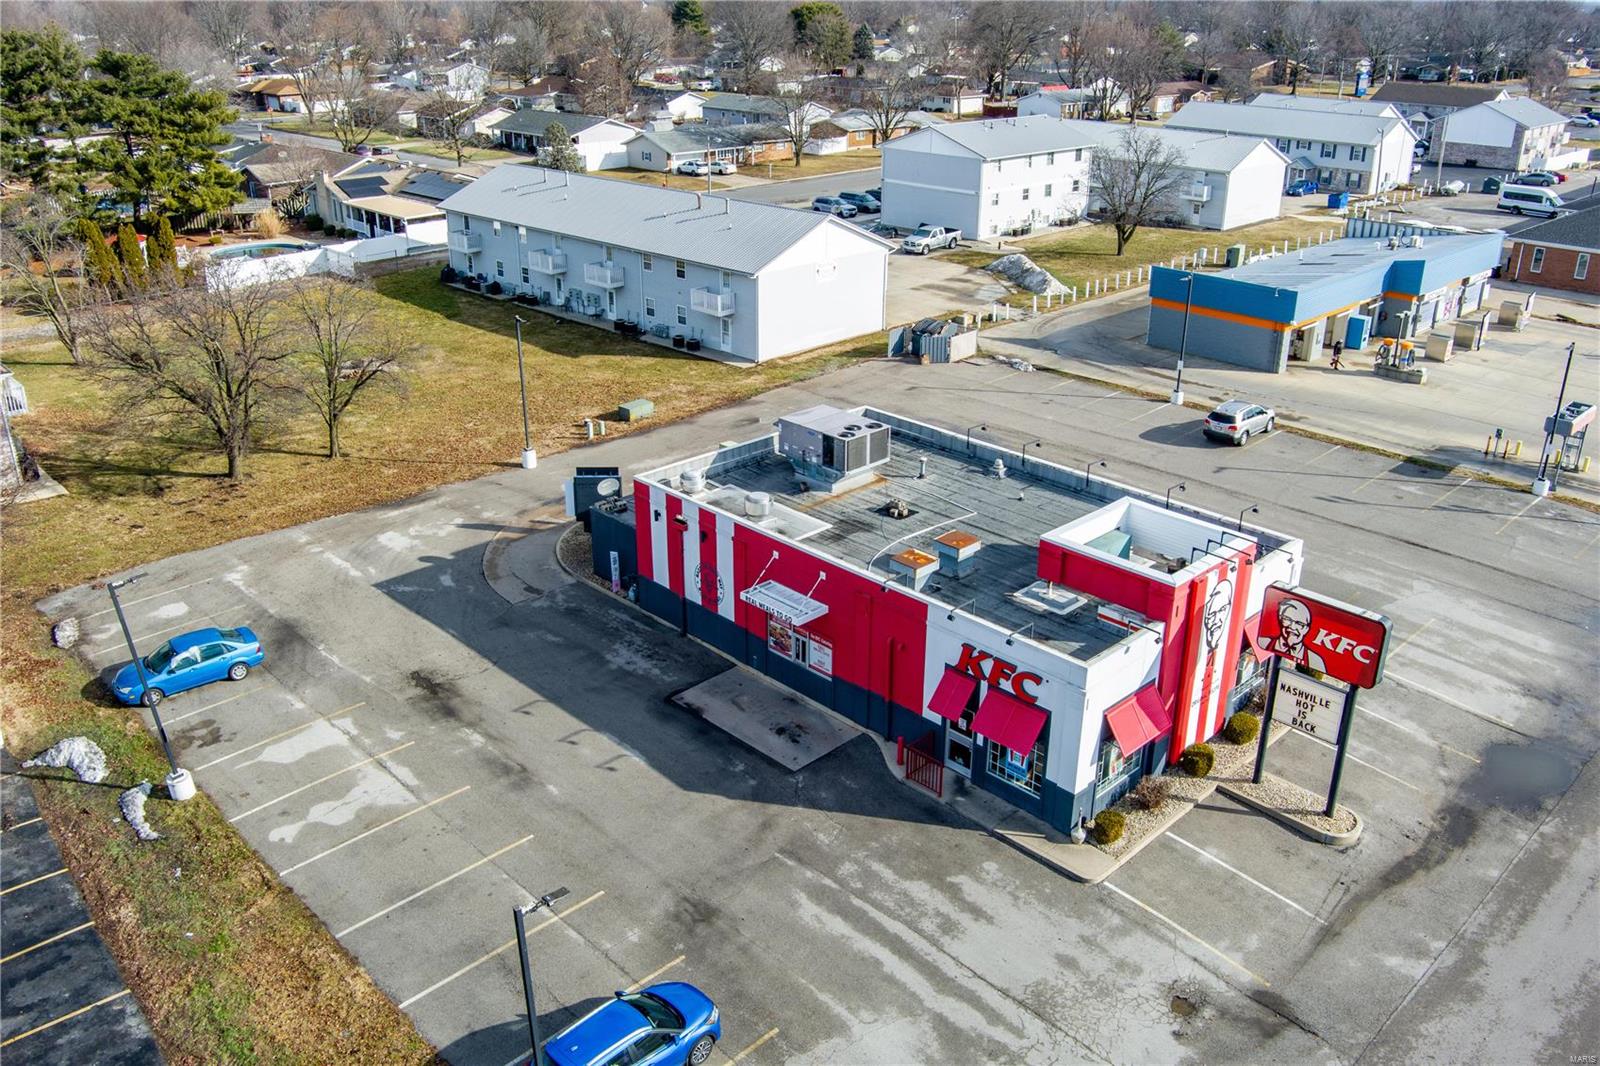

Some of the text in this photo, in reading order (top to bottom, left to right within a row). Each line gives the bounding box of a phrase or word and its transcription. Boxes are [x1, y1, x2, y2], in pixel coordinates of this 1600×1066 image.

[745, 595, 757, 607] REAL
[758, 601, 775, 616] MEALS
[1312, 628, 1376, 664] KFC
[954, 642, 1043, 705] KFC
[1280, 682, 1331, 709] NASHVILLE
[1296, 698, 1315, 712] HOT
[1297, 709, 1308, 720] IS
[1291, 717, 1317, 734] BACK
